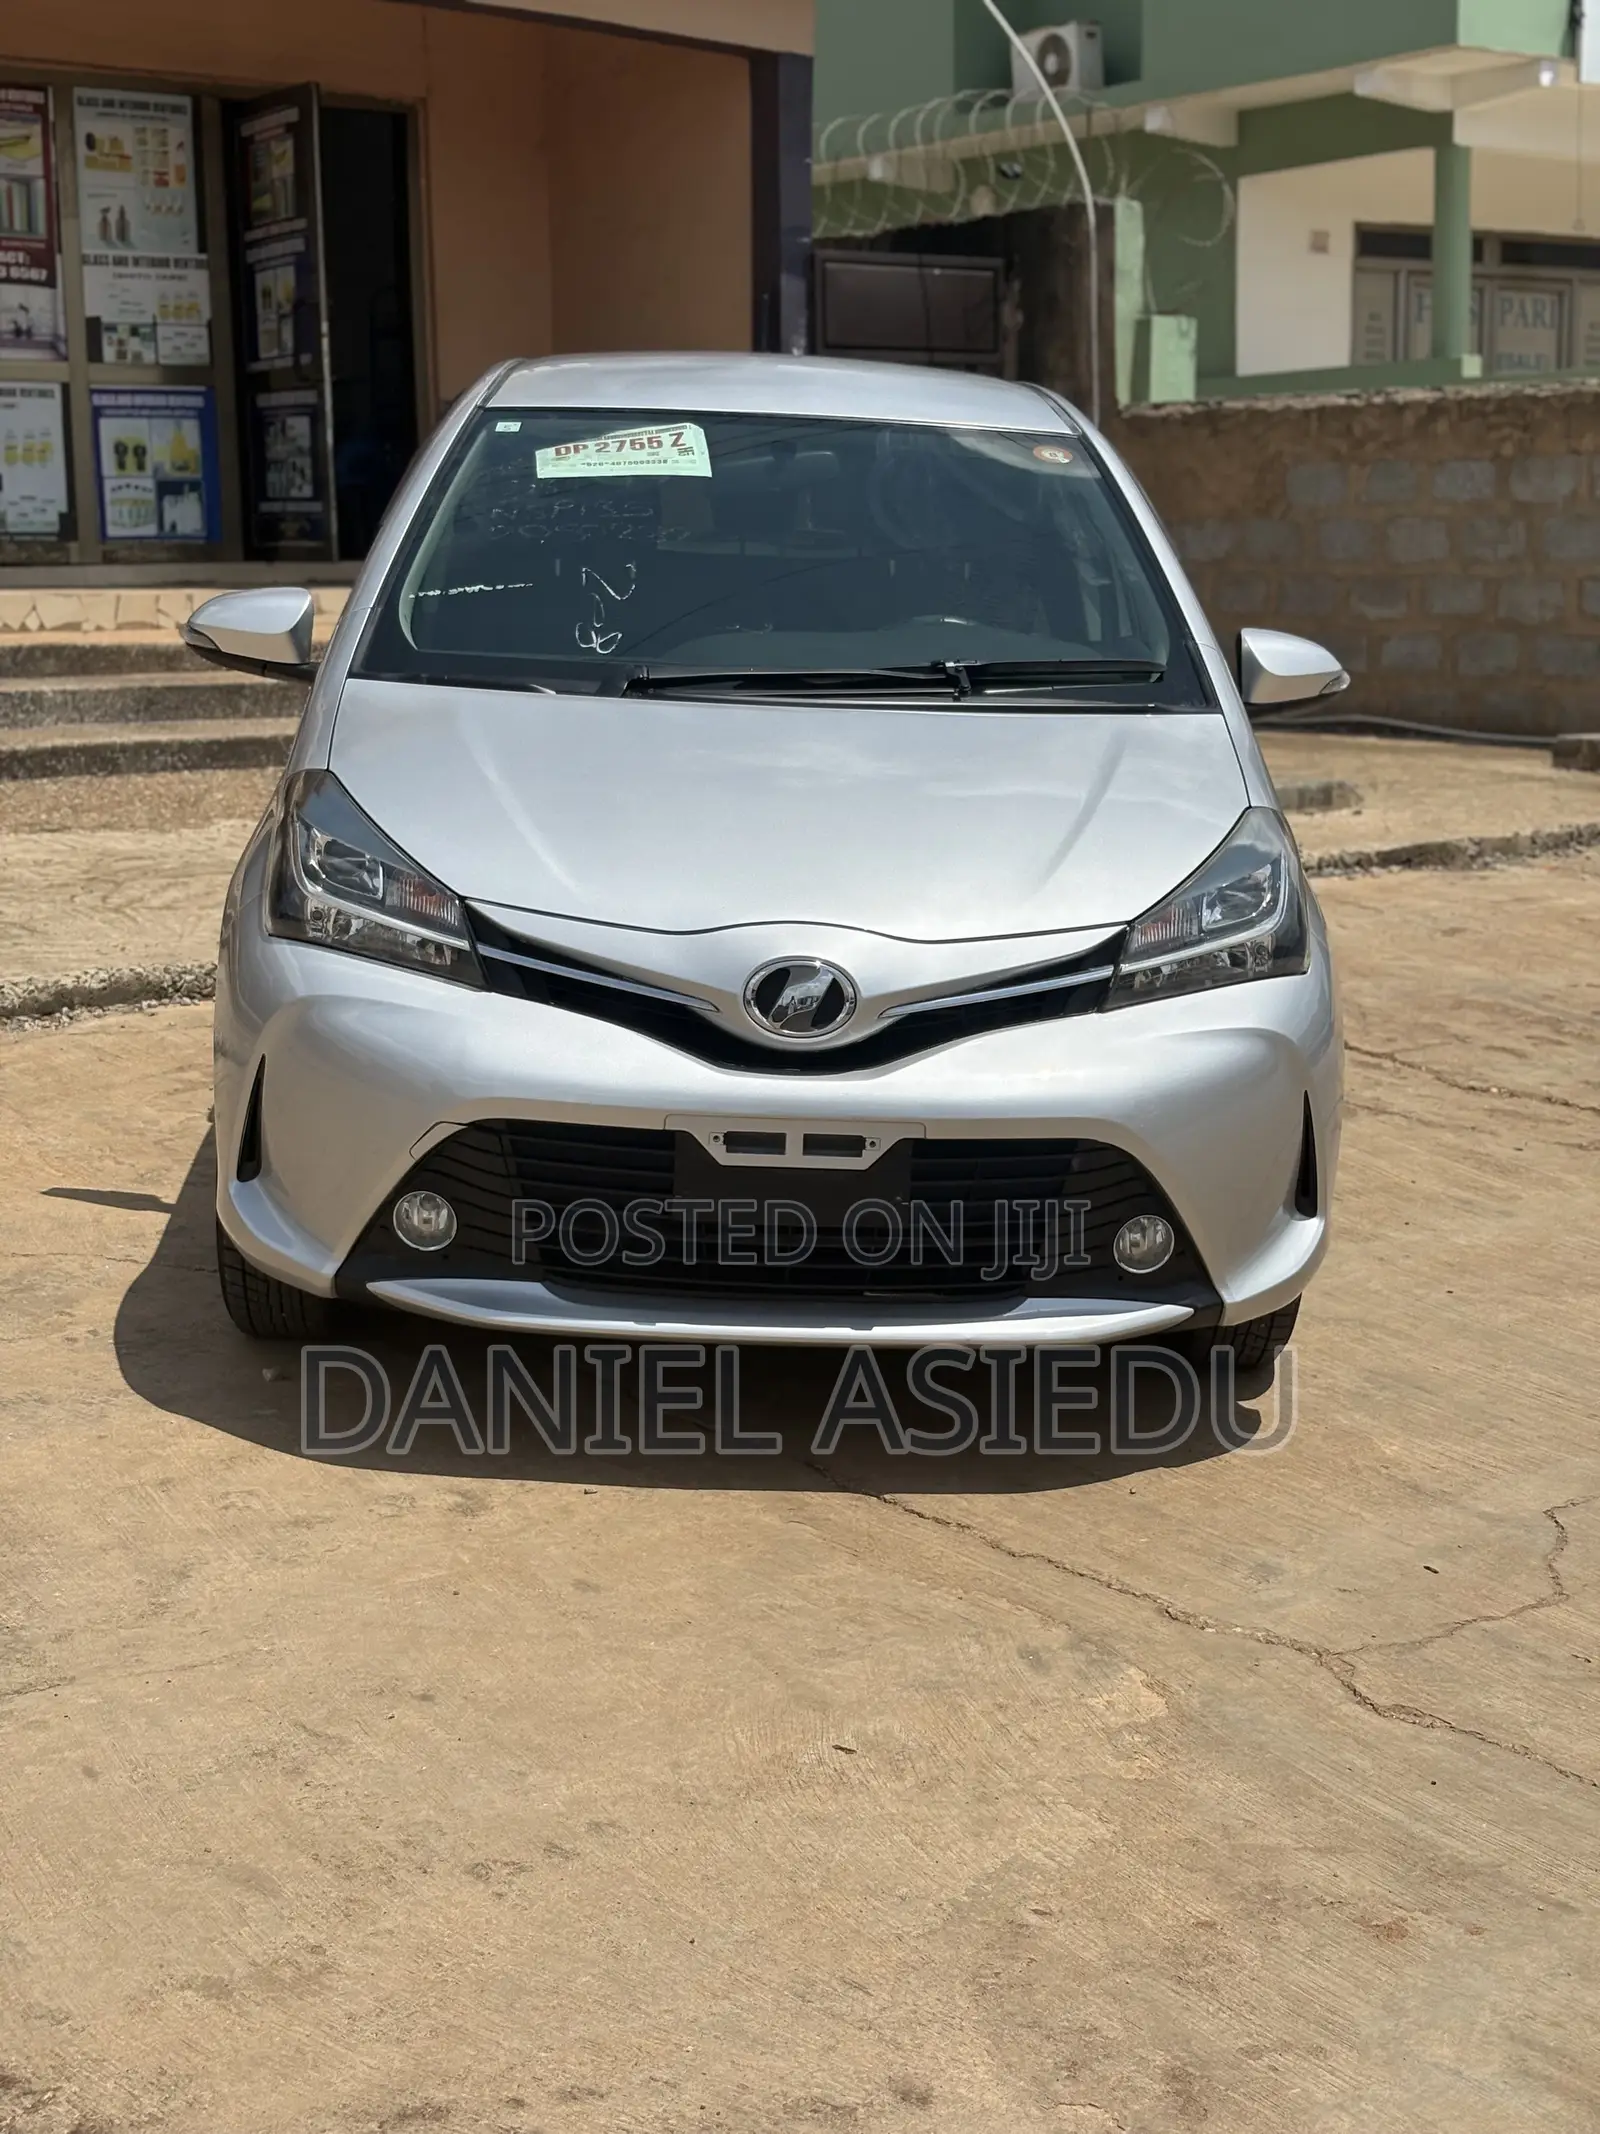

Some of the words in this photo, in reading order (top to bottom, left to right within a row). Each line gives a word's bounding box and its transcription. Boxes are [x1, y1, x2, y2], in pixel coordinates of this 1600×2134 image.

[554, 443, 589, 457] DP
[594, 436, 663, 453] 2755
[668, 431, 687, 447] Z
